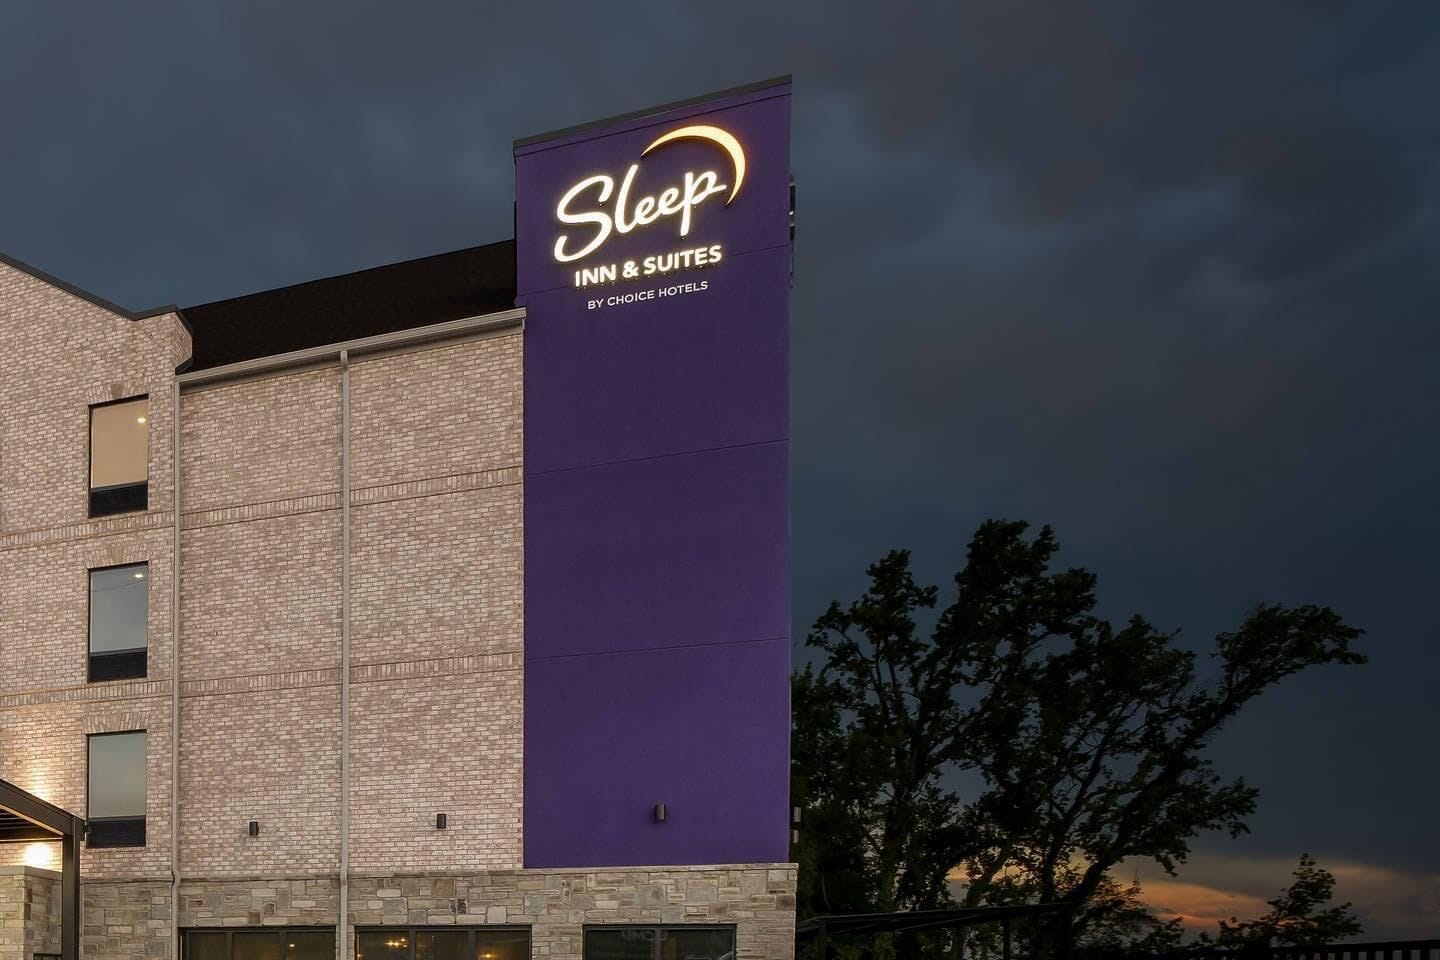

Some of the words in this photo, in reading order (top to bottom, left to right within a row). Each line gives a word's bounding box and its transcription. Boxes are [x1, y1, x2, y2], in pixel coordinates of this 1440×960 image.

[554, 164, 727, 262] Sleep
[575, 264, 617, 287] INN
[623, 260, 639, 279] &
[643, 245, 722, 275] SUITES
[587, 299, 604, 310] BY
[607, 290, 655, 307] CHOICE
[659, 281, 709, 298] HOTELS
